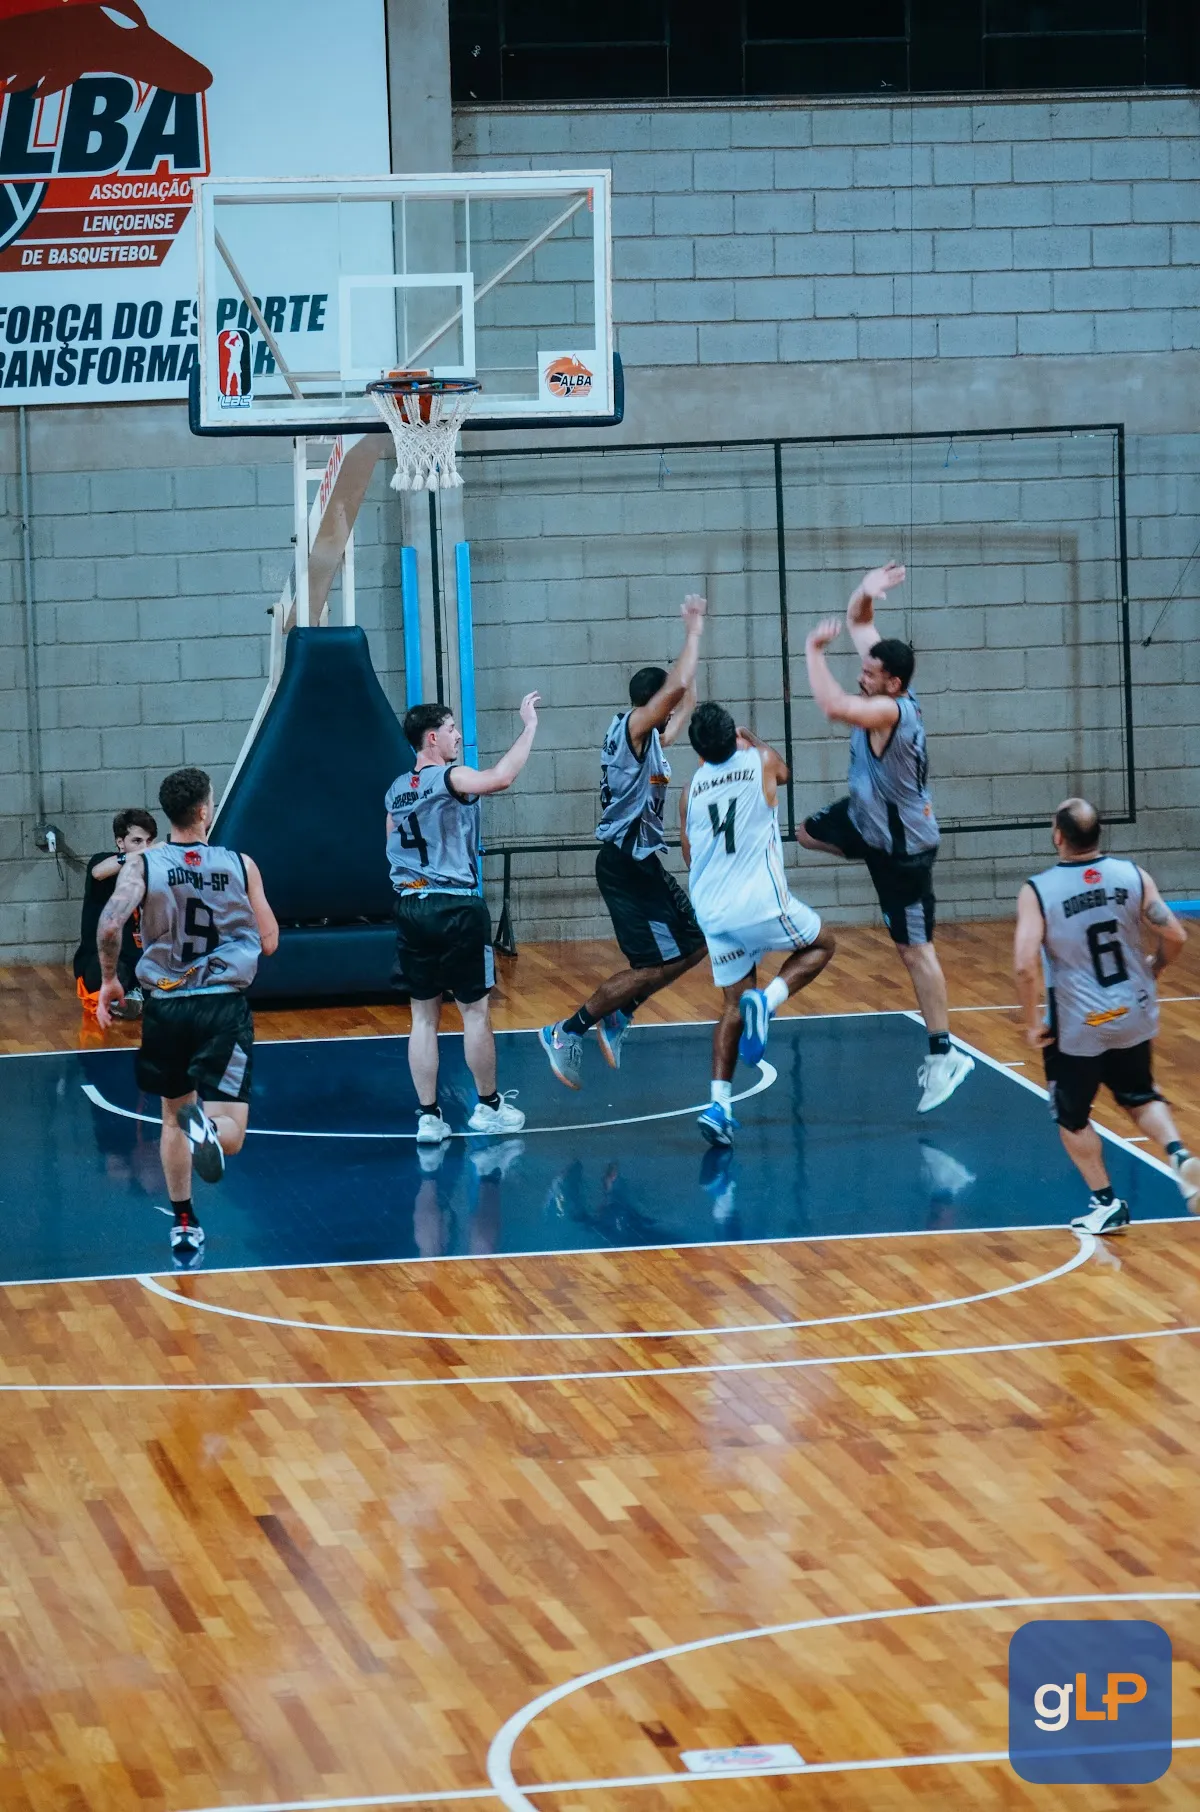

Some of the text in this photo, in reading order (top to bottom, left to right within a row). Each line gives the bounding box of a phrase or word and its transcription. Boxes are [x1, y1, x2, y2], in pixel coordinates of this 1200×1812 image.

[0, 77, 201, 174] LBA
[90, 178, 191, 202] ASSOCIAÇÃO
[83, 213, 175, 236] LENÇOENSE
[21, 245, 158, 266] DE BASQUETEBOL
[112, 300, 163, 339] DO
[560, 375, 592, 387] ALBA
[397, 811, 429, 867] 4
[708, 797, 737, 854] 4
[181, 897, 219, 963] 9
[1086, 919, 1129, 988] 6
